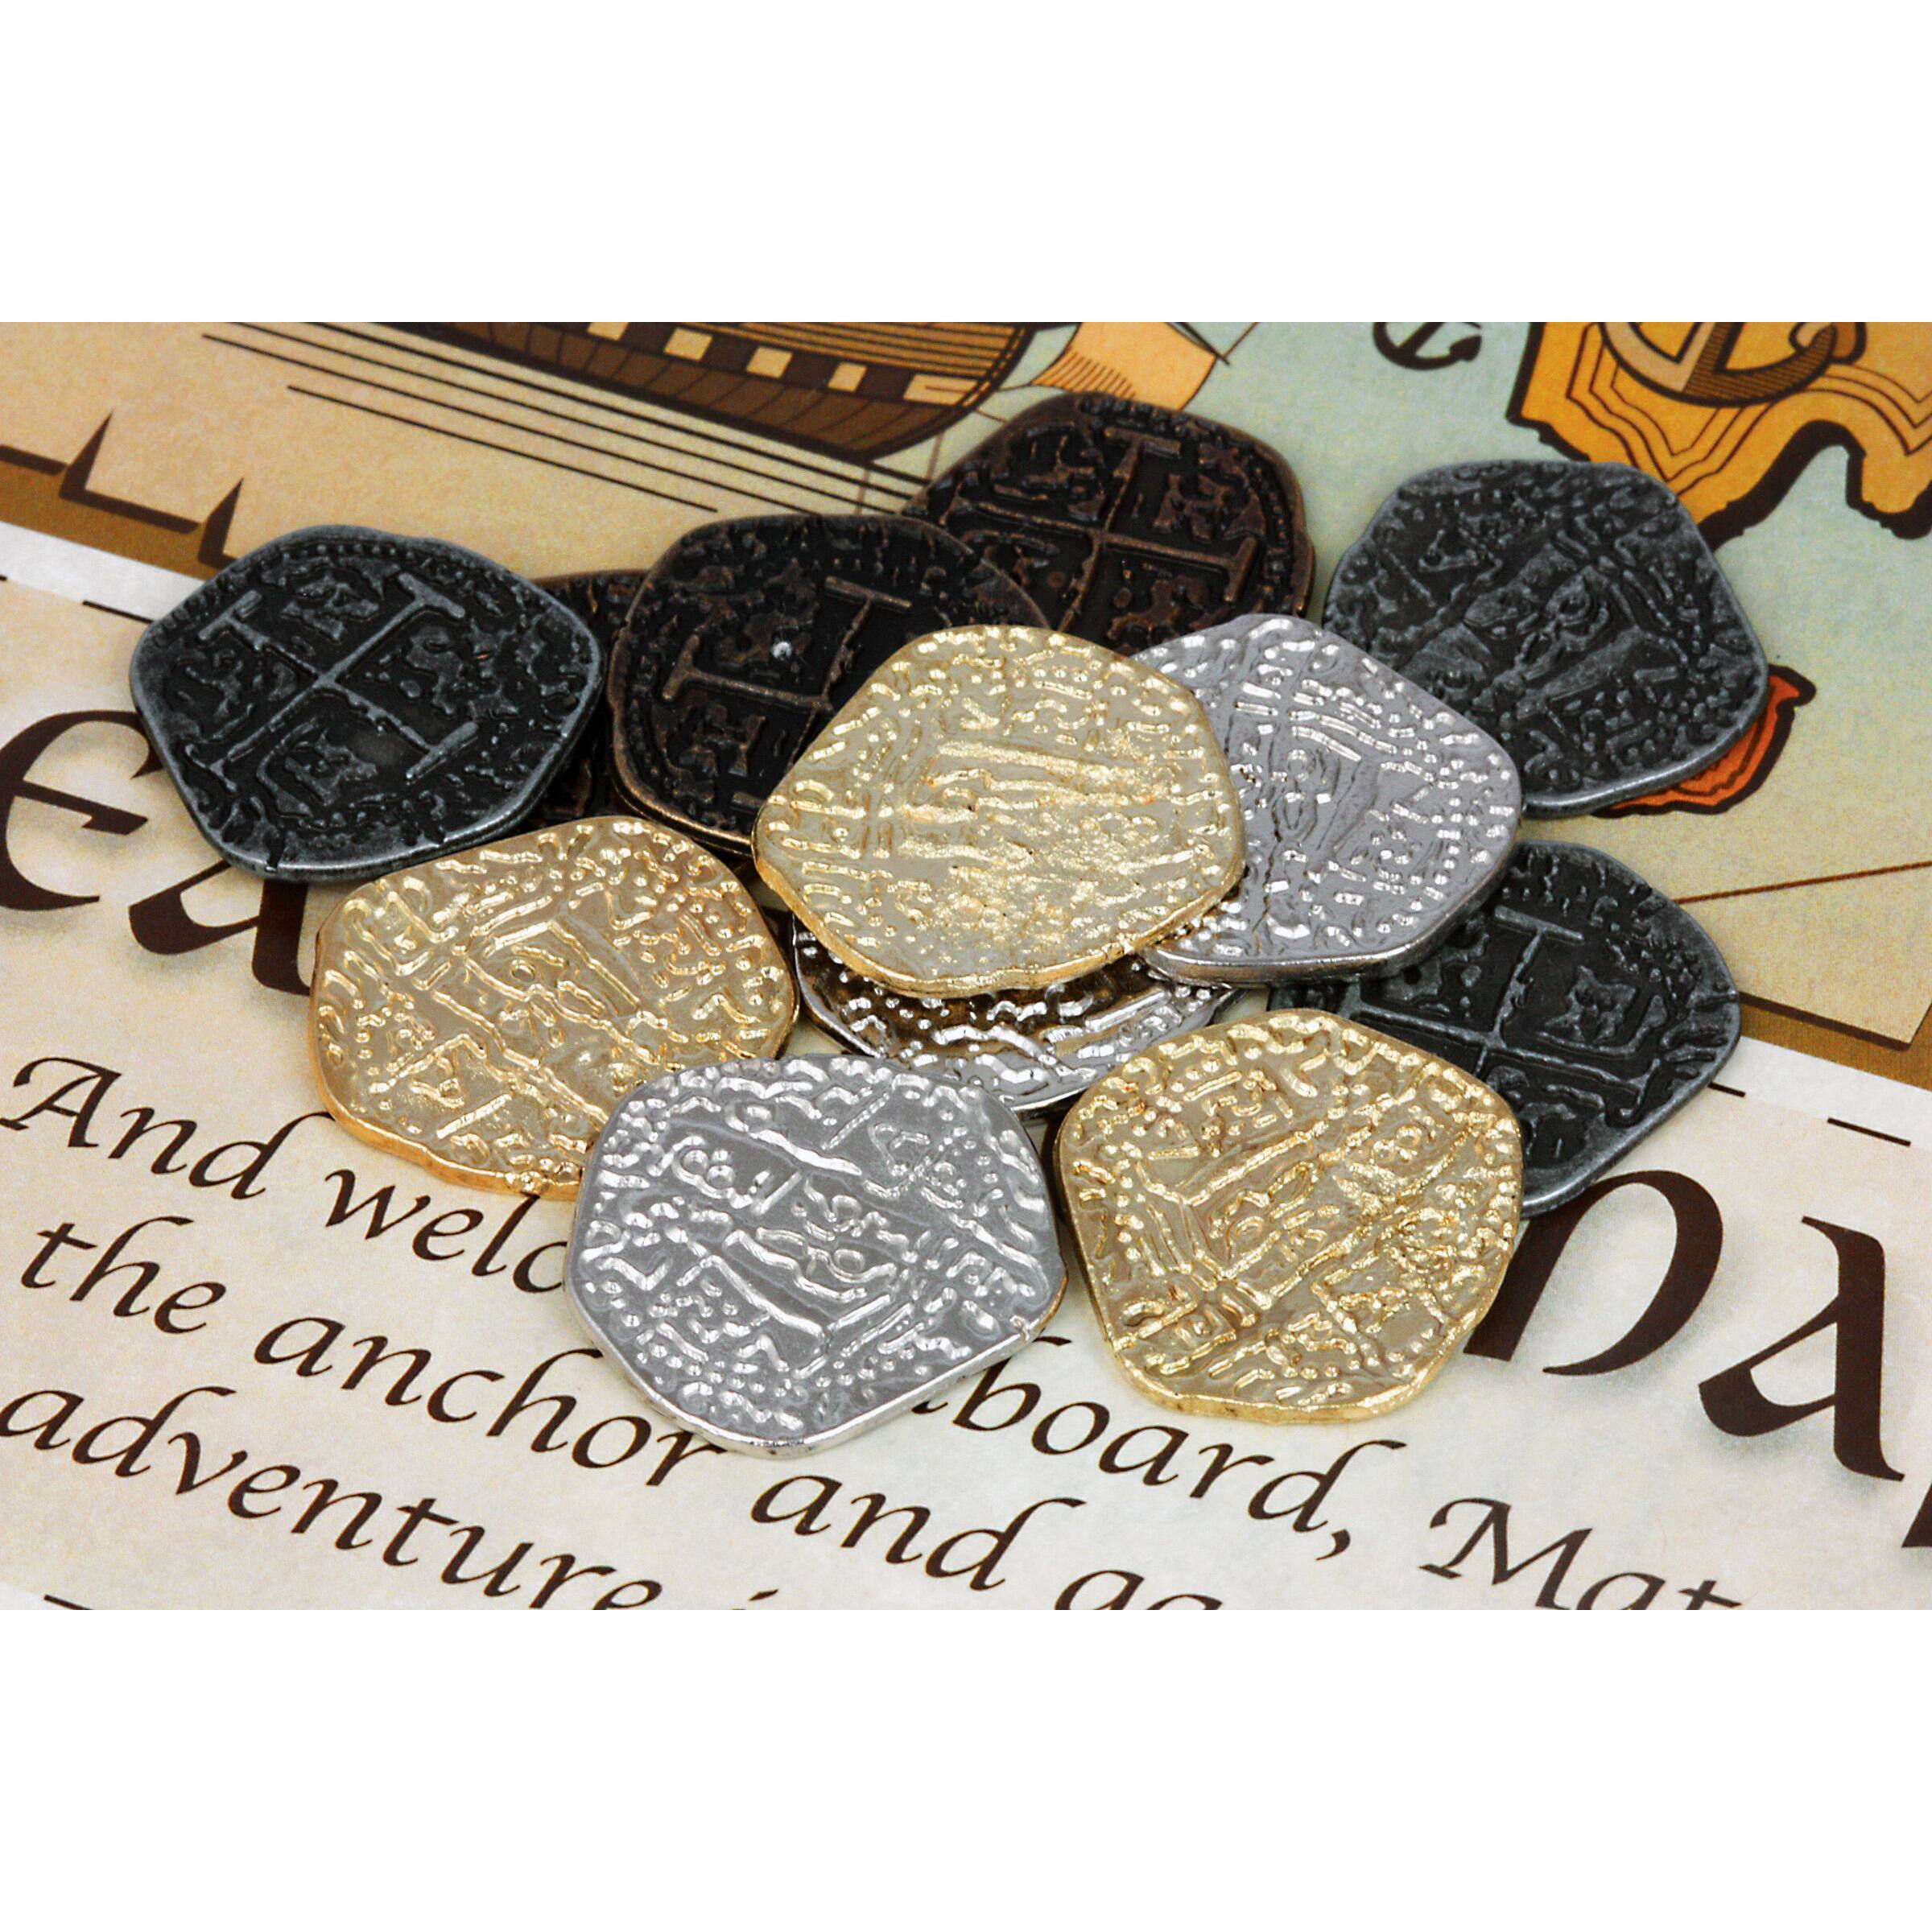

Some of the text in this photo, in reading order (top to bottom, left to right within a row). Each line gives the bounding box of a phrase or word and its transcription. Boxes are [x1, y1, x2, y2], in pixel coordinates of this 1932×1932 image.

[0, 1057, 336, 1199] And
[910, 1335, 1407, 1559] board,
[21, 1216, 1086, 1591] the anchor and
[0, 1386, 663, 1610] adventure
